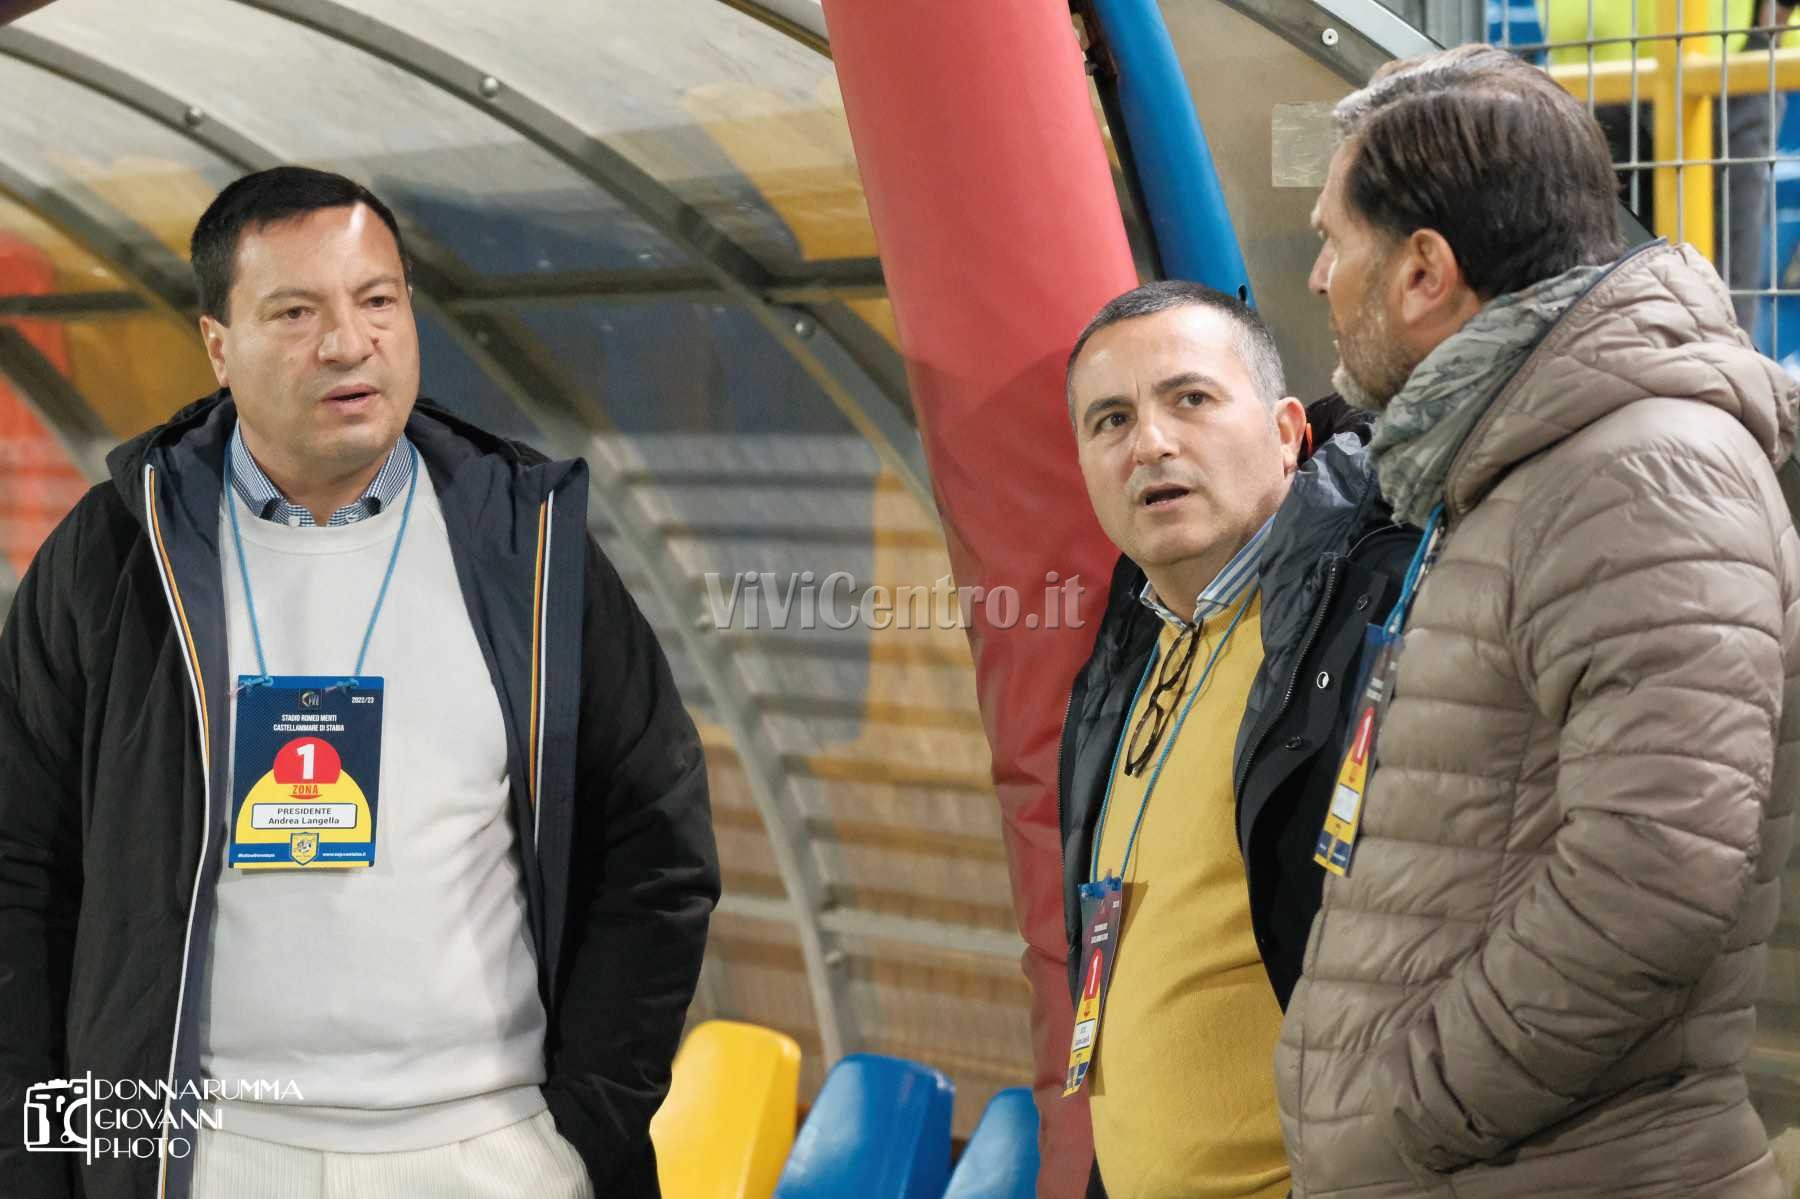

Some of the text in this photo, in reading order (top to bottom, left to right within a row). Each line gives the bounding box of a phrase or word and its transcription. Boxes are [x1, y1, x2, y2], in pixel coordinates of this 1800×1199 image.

[351, 696, 375, 704] 2022/23
[281, 714, 337, 722] STADIO ROMEO MENTI
[273, 724, 345, 732] CASTELLAMMARE DI STABIA
[296, 743, 316, 780] 1
[292, 784, 319, 795] ZONA
[277, 807, 332, 815] PRESIDENTE
[268, 817, 340, 826] Andrea Langella
